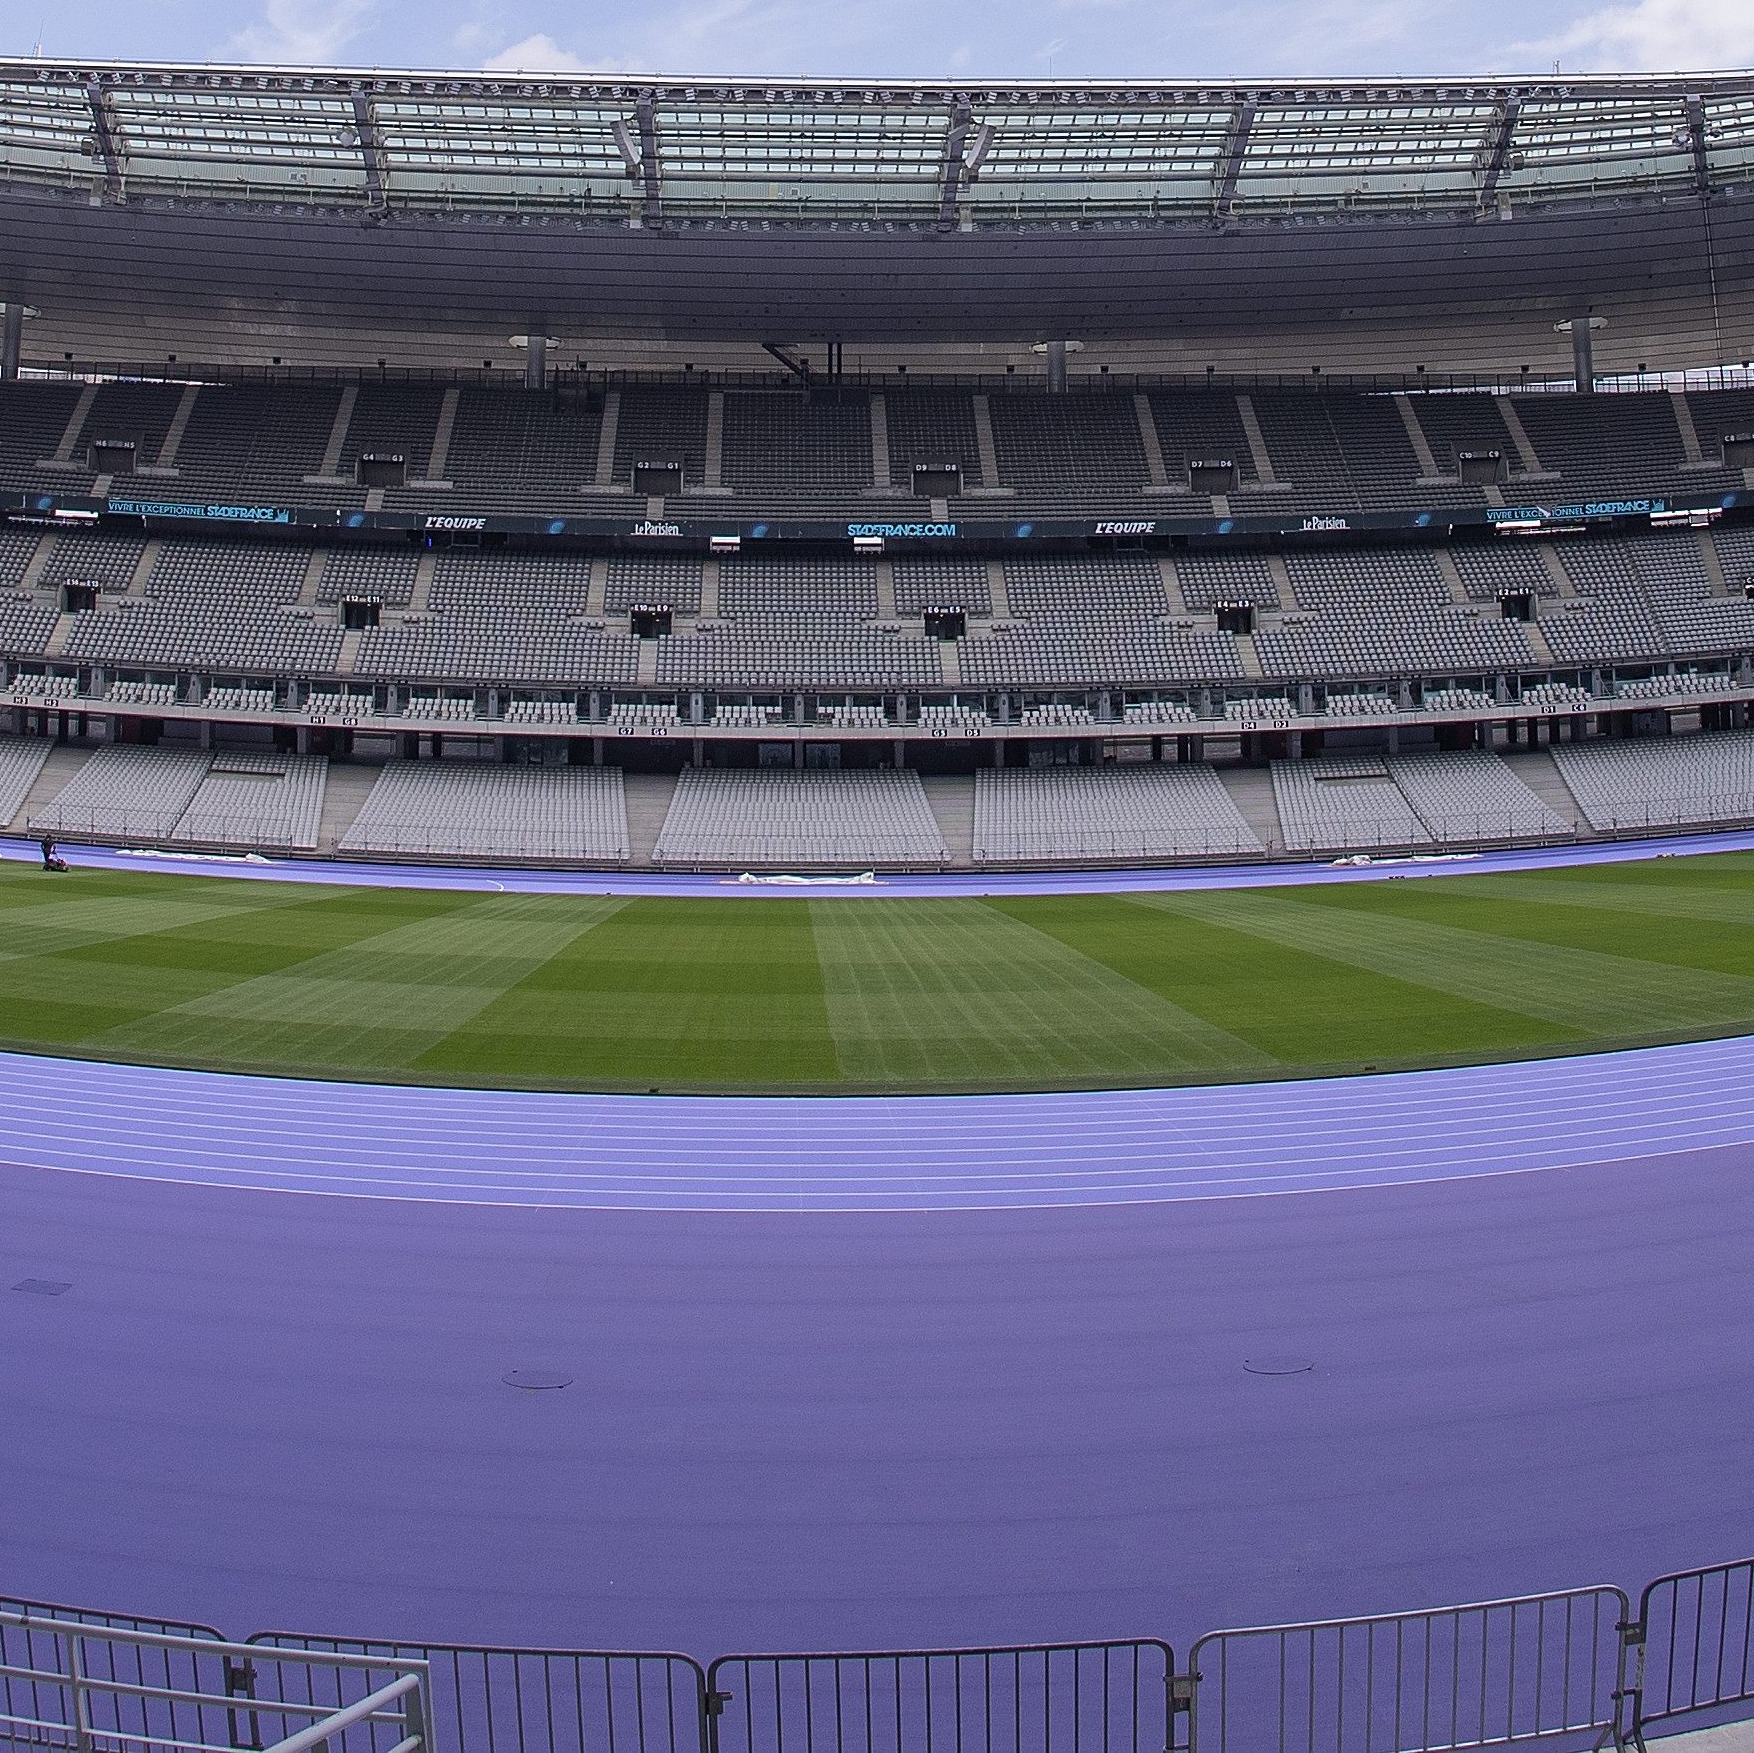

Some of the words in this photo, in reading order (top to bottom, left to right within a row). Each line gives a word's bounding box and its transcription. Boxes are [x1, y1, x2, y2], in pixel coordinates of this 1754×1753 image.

[363, 453, 374, 461] G4
[392, 454, 403, 462] G3
[1488, 450, 1500, 458] C9
[637, 461, 649, 469] G2
[1191, 460, 1203, 468] D7
[108, 502, 134, 512] VIVRE
[136, 504, 206, 516] L'EXCEPTIONNEL
[207, 505, 274, 520] STADEFRANCE
[1486, 511, 1512, 520] VIVRE
[1514, 507, 1585, 518] L'EXCEIONNEL
[1585, 500, 1650, 515] STADEFRANCE
[644, 520, 679, 535] Parisien
[1311, 516, 1346, 530] Parisien
[656, 604, 668, 612] E9
